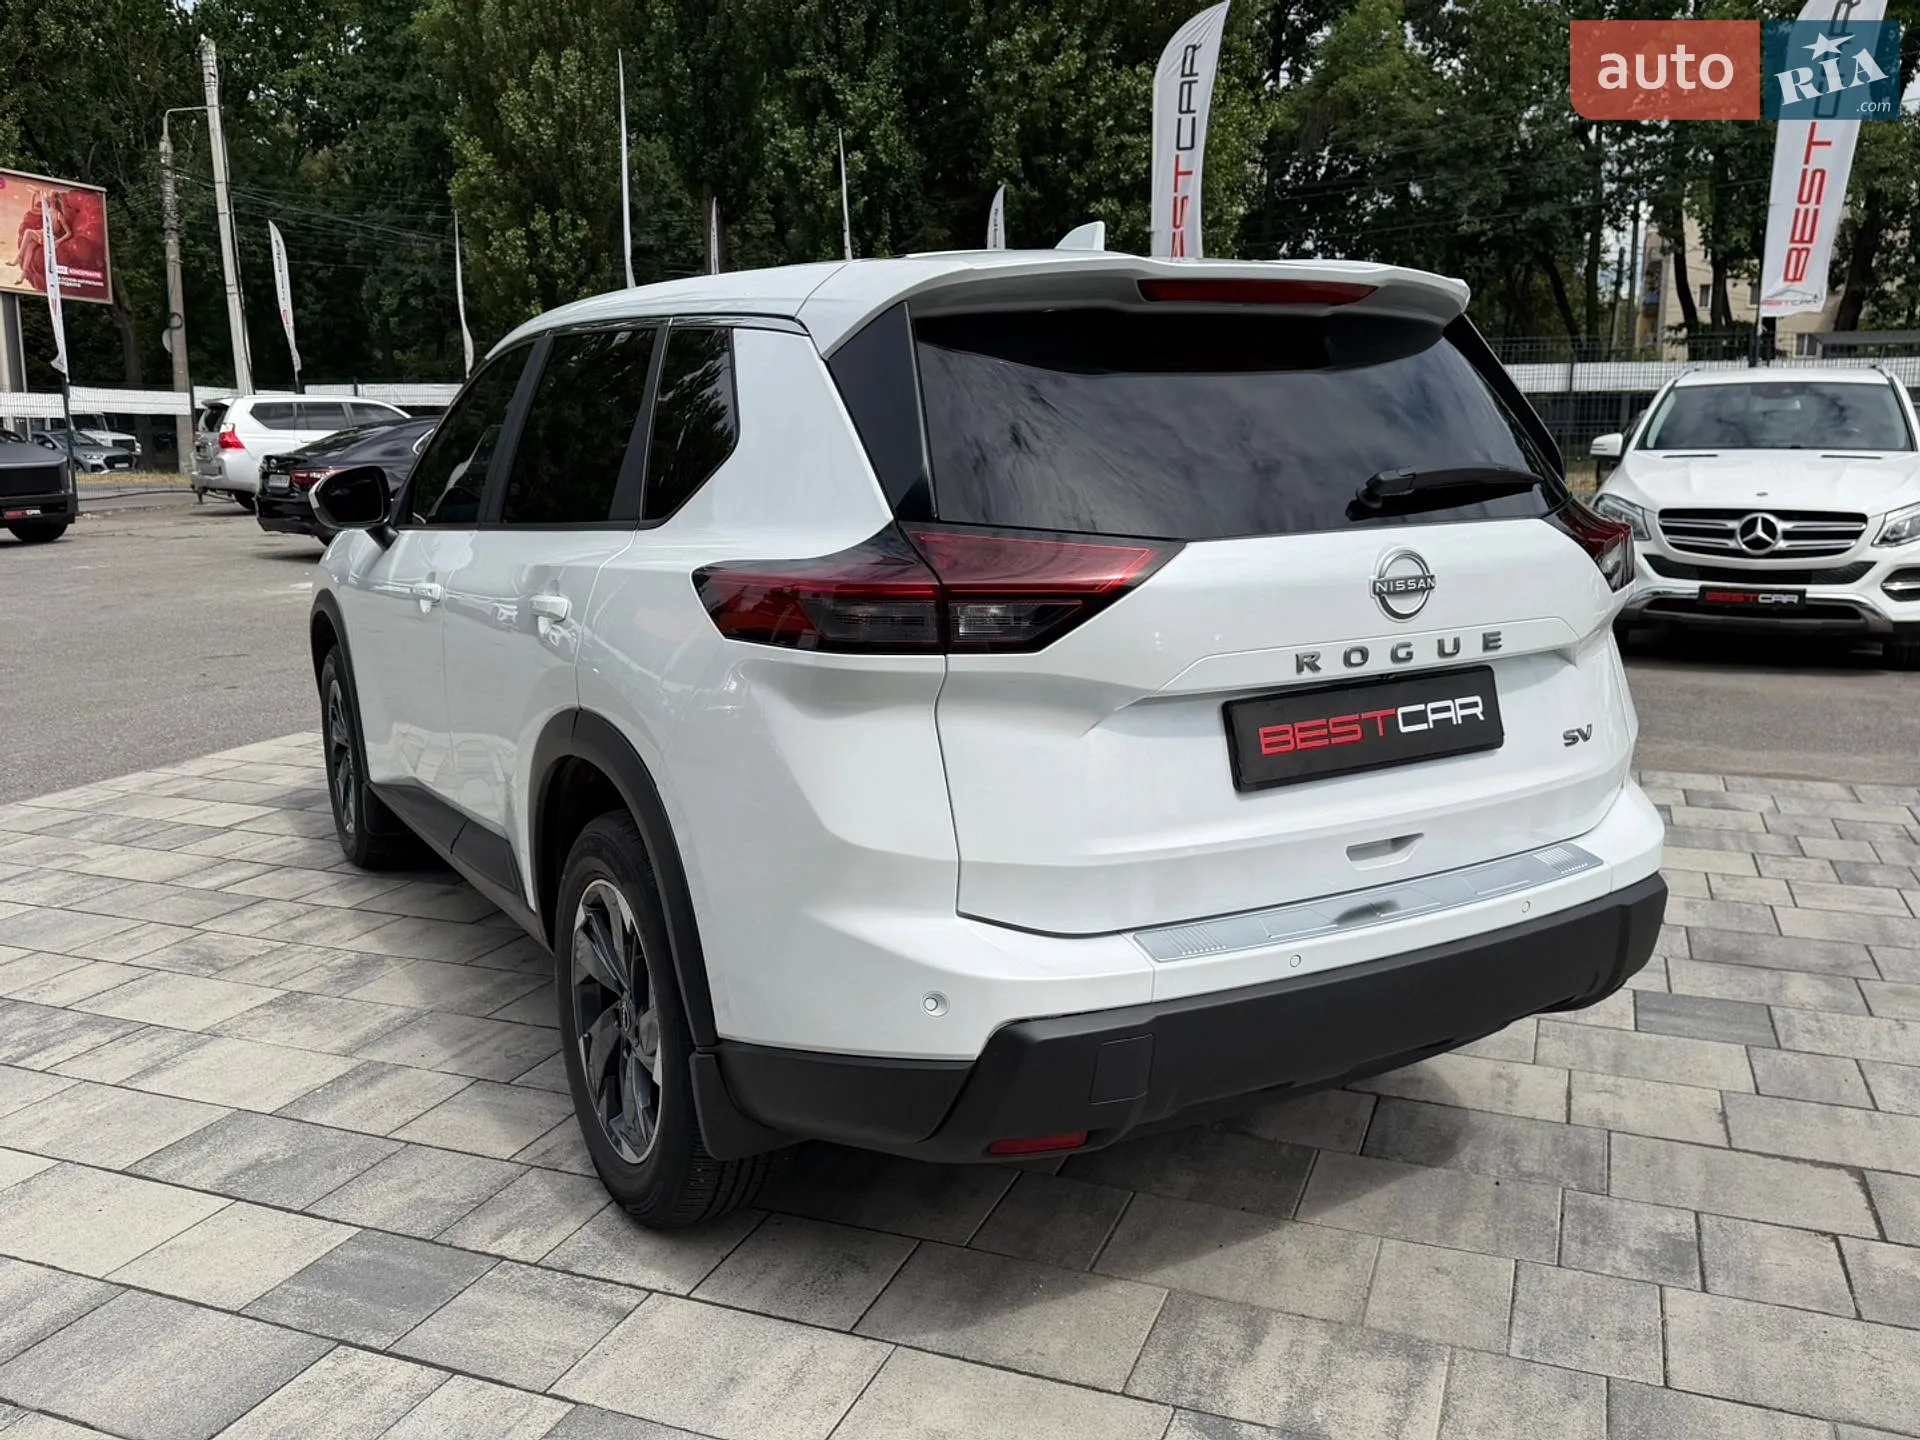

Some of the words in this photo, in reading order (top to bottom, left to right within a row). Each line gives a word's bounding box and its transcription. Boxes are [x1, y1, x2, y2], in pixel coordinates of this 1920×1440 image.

[1170, 44, 1203, 258] ESTCAR
[1375, 577, 1436, 592] NISSAN
[1295, 630, 1503, 675] ROGUE
[1258, 694, 1486, 756] BESTCAR
[1562, 723, 1593, 747] SV
